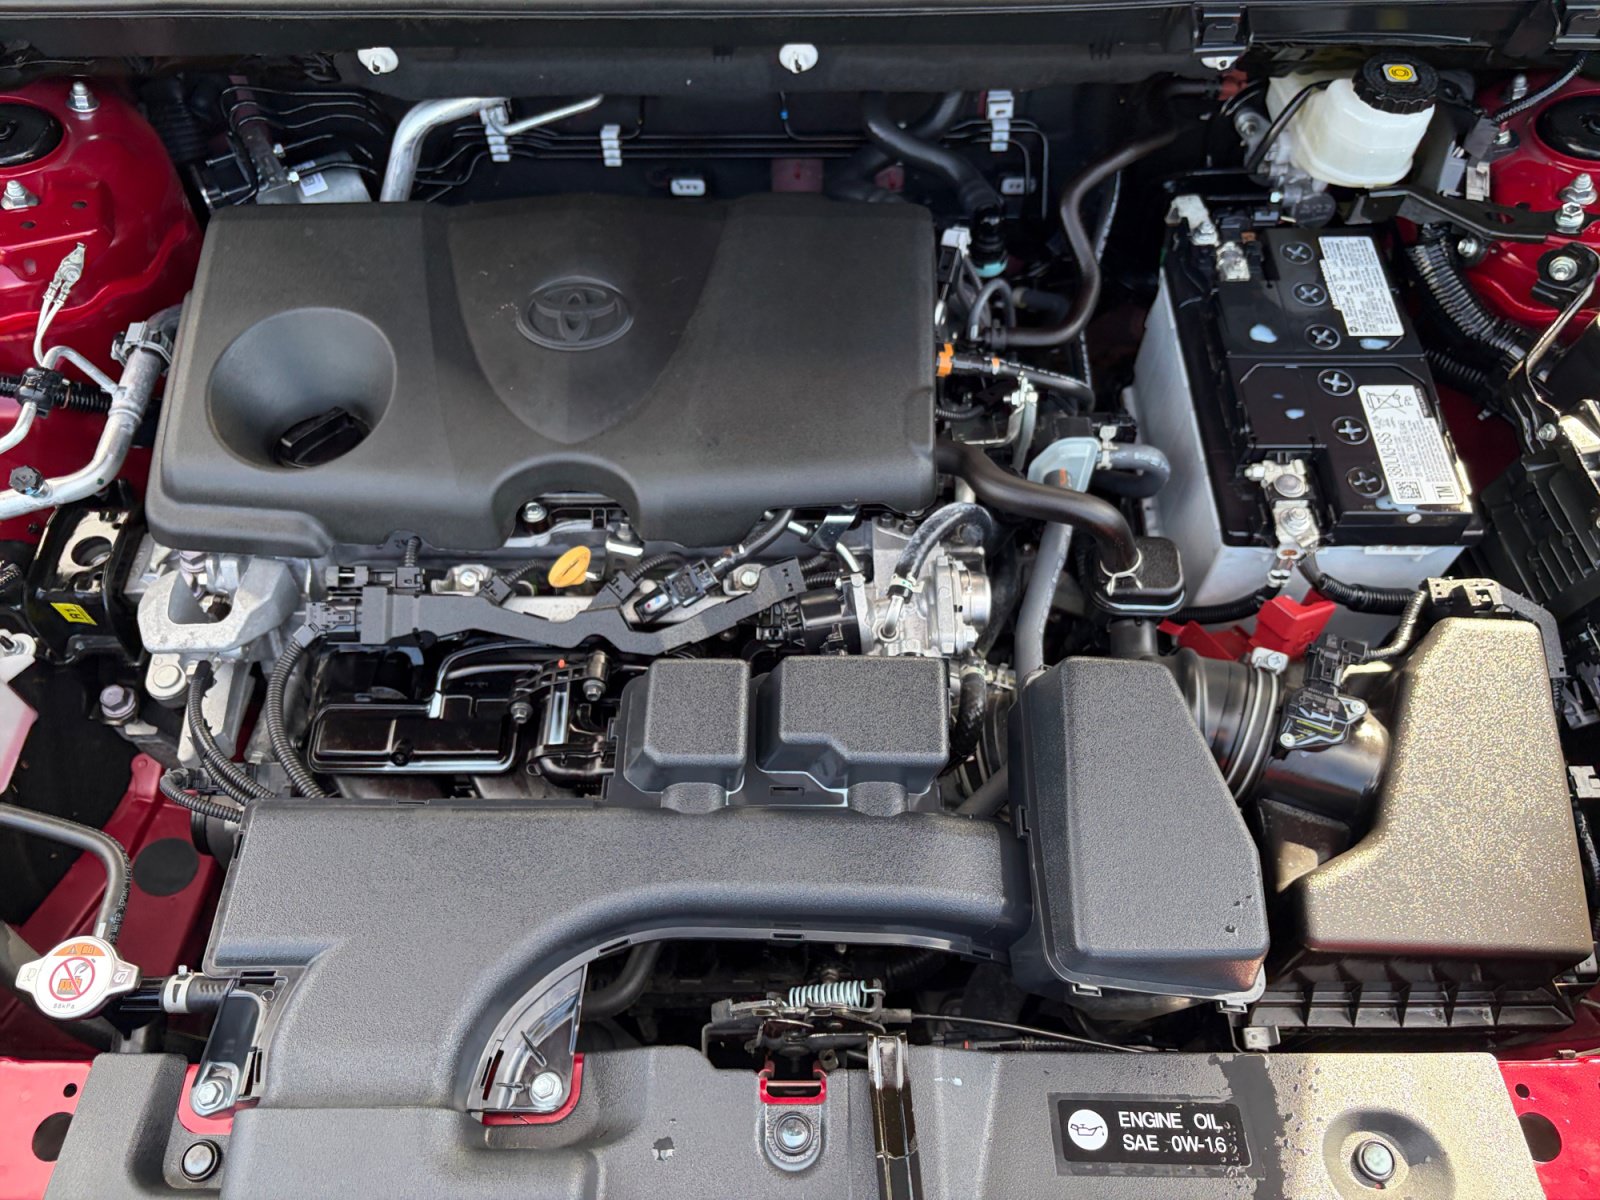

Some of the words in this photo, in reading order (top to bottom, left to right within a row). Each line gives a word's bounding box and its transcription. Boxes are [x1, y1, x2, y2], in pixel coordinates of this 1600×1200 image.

[1434, 485, 1455, 499] TM
[1118, 1111, 1184, 1129] ENGINE
[1193, 1112, 1224, 1130] OIL
[1122, 1133, 1160, 1152] SAE
[1170, 1135, 1228, 1154] 0W-16
